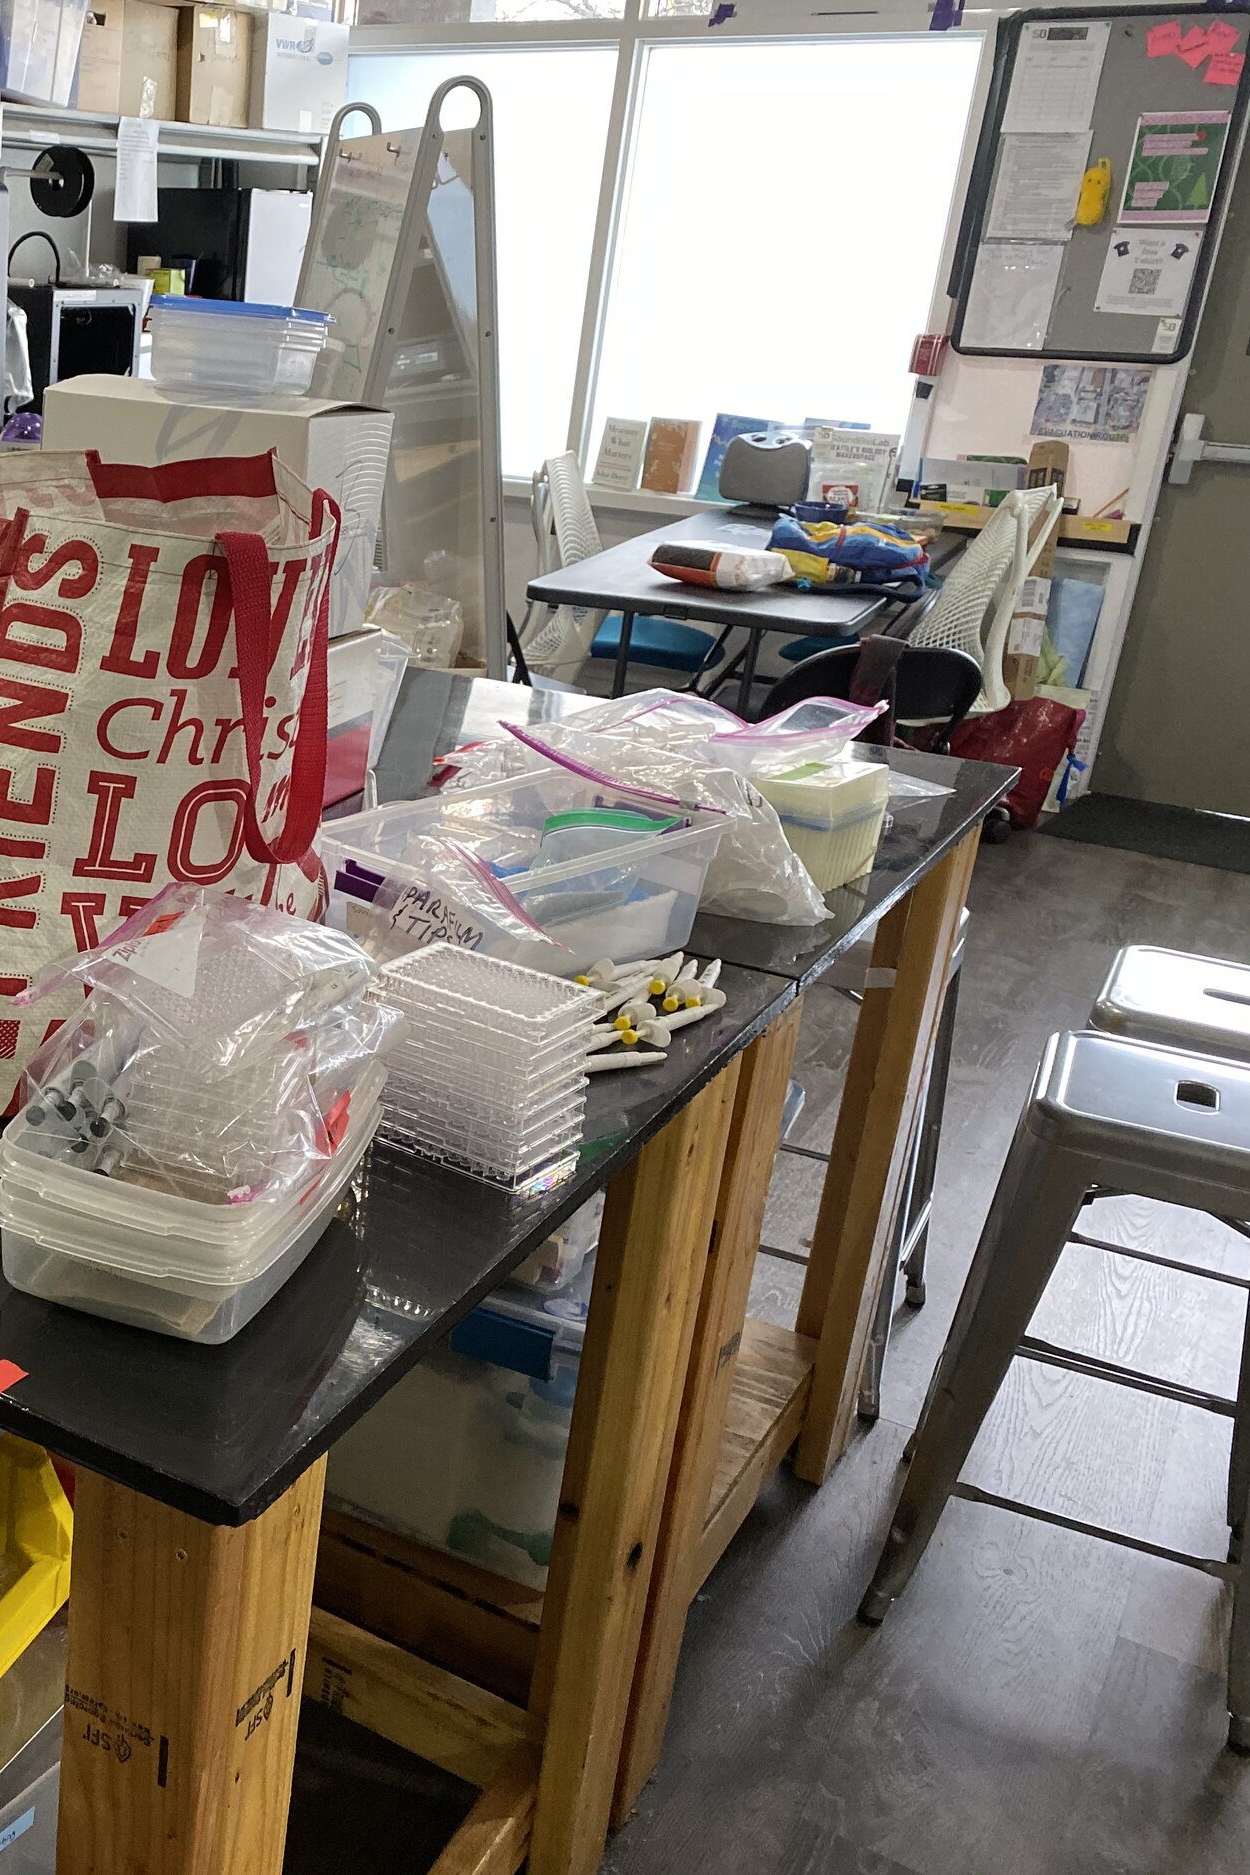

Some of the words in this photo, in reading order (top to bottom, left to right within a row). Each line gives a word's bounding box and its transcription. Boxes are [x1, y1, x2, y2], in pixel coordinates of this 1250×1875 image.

[276, 39, 296, 50] VWR
[1038, 427, 1095, 439] EVACUATION
[610, 436, 631, 447] What
[604, 447, 632, 460] Matters
[403, 886, 484, 950] PARAFILM
